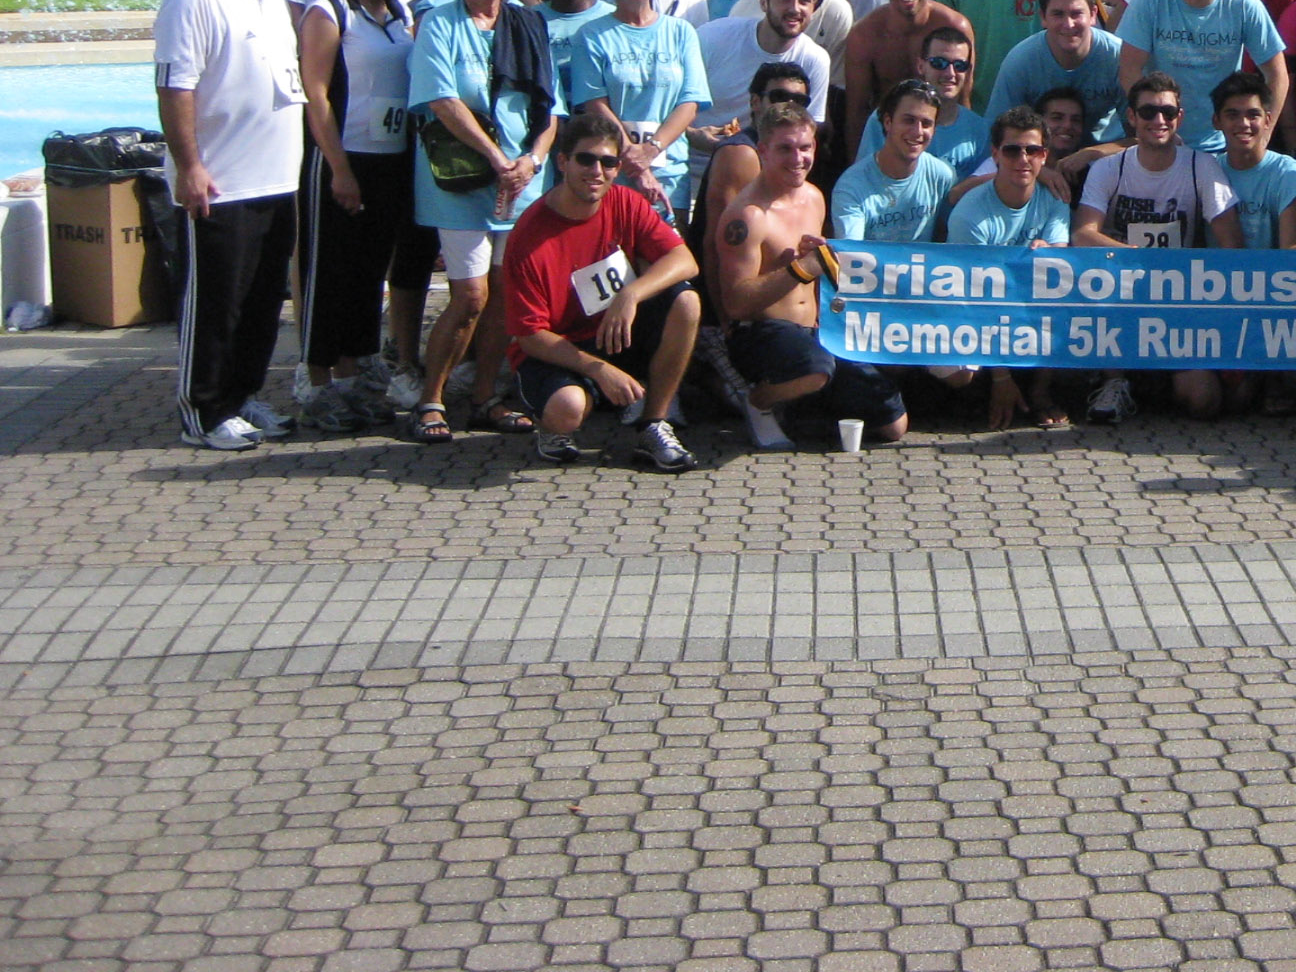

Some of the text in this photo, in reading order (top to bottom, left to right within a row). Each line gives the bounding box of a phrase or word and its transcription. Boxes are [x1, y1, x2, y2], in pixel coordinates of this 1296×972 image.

[1156, 28, 1195, 44] KAPPA
[383, 106, 404, 134] 49
[54, 223, 105, 245] TRASH
[591, 267, 624, 301] 18
[837, 251, 1006, 298] Brian
[845, 311, 1051, 356] Memorial
[1068, 316, 1122, 358] 5k
[1138, 317, 1221, 358] Run
[1235, 318, 1249, 359] /
